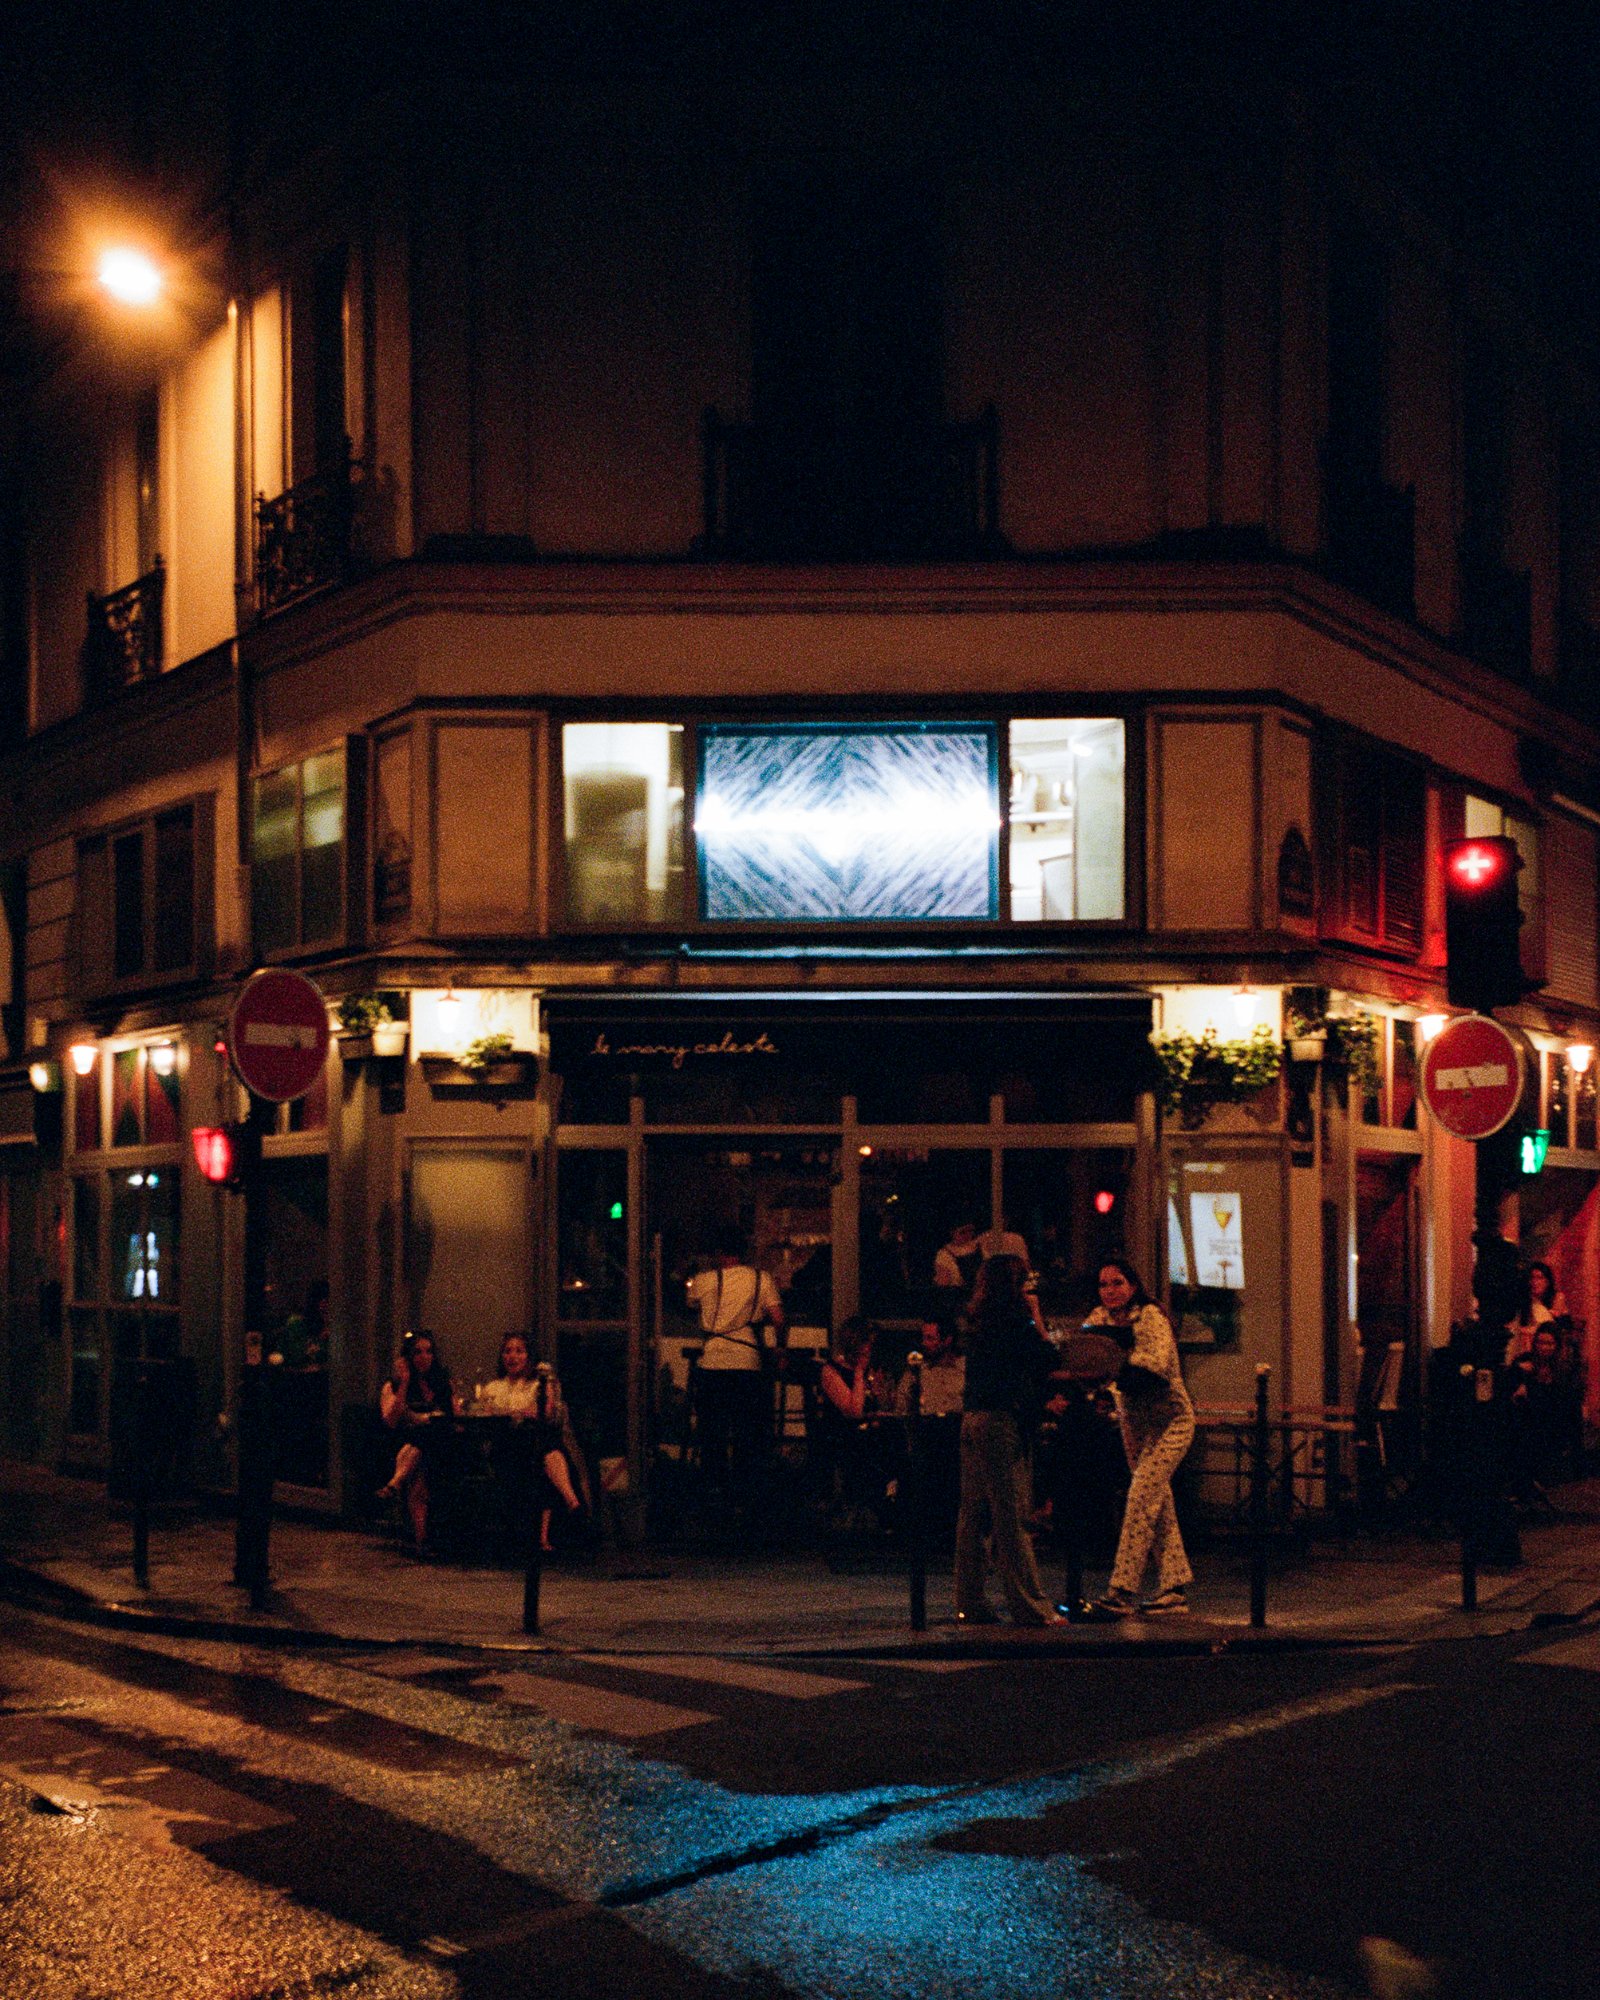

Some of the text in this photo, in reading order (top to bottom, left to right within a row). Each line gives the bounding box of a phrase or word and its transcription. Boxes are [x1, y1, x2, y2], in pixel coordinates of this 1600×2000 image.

[592, 1031, 779, 1069] le mary celeste
